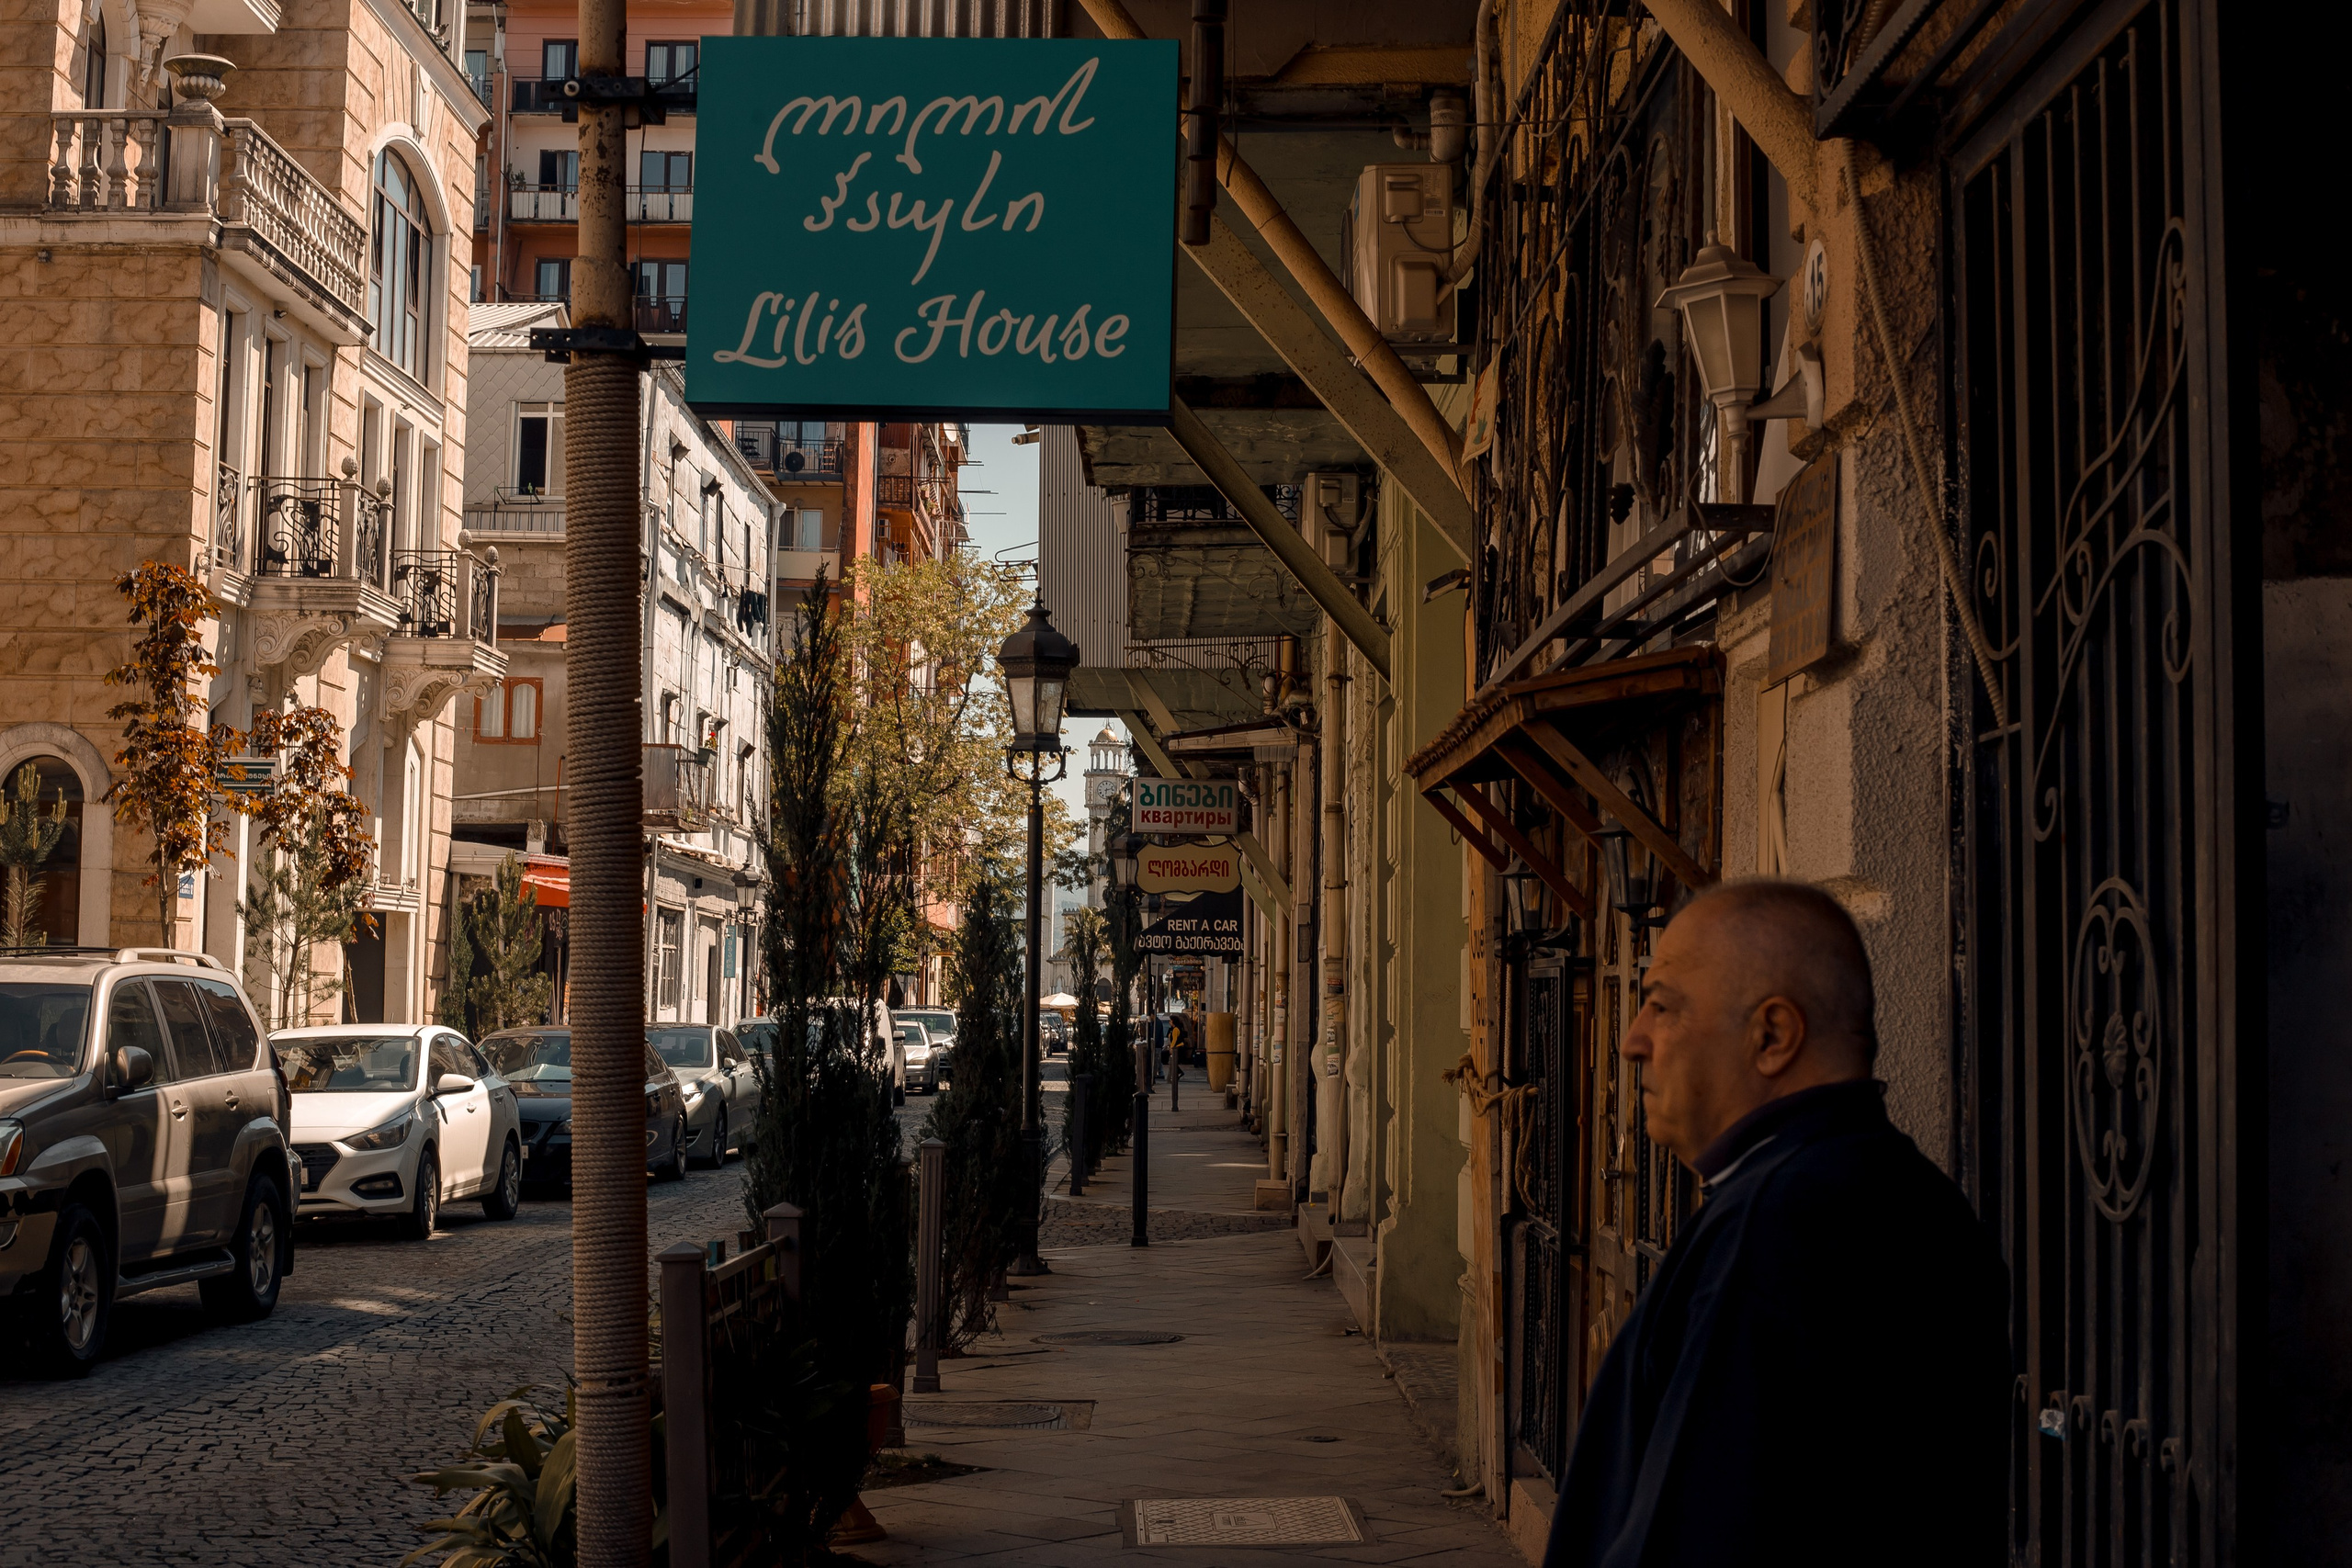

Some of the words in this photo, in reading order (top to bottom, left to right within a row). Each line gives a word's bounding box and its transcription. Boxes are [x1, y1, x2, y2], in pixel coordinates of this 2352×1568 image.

[753, 56, 1100, 175] ლილის
[802, 149, 1046, 286] ჰაუსი
[1810, 249, 1824, 317] 15
[712, 290, 868, 369] Lilis
[893, 288, 1131, 365] House
[1139, 783, 1233, 809] ბინები
[1141, 809, 1231, 829] квартиры
[1148, 859, 1230, 878] ლომბარდი
[1167, 919, 1198, 931] RENT
[1200, 919, 1210, 931] A
[1213, 919, 1238, 932] CAR
[1137, 933, 1172, 949] ავტო
